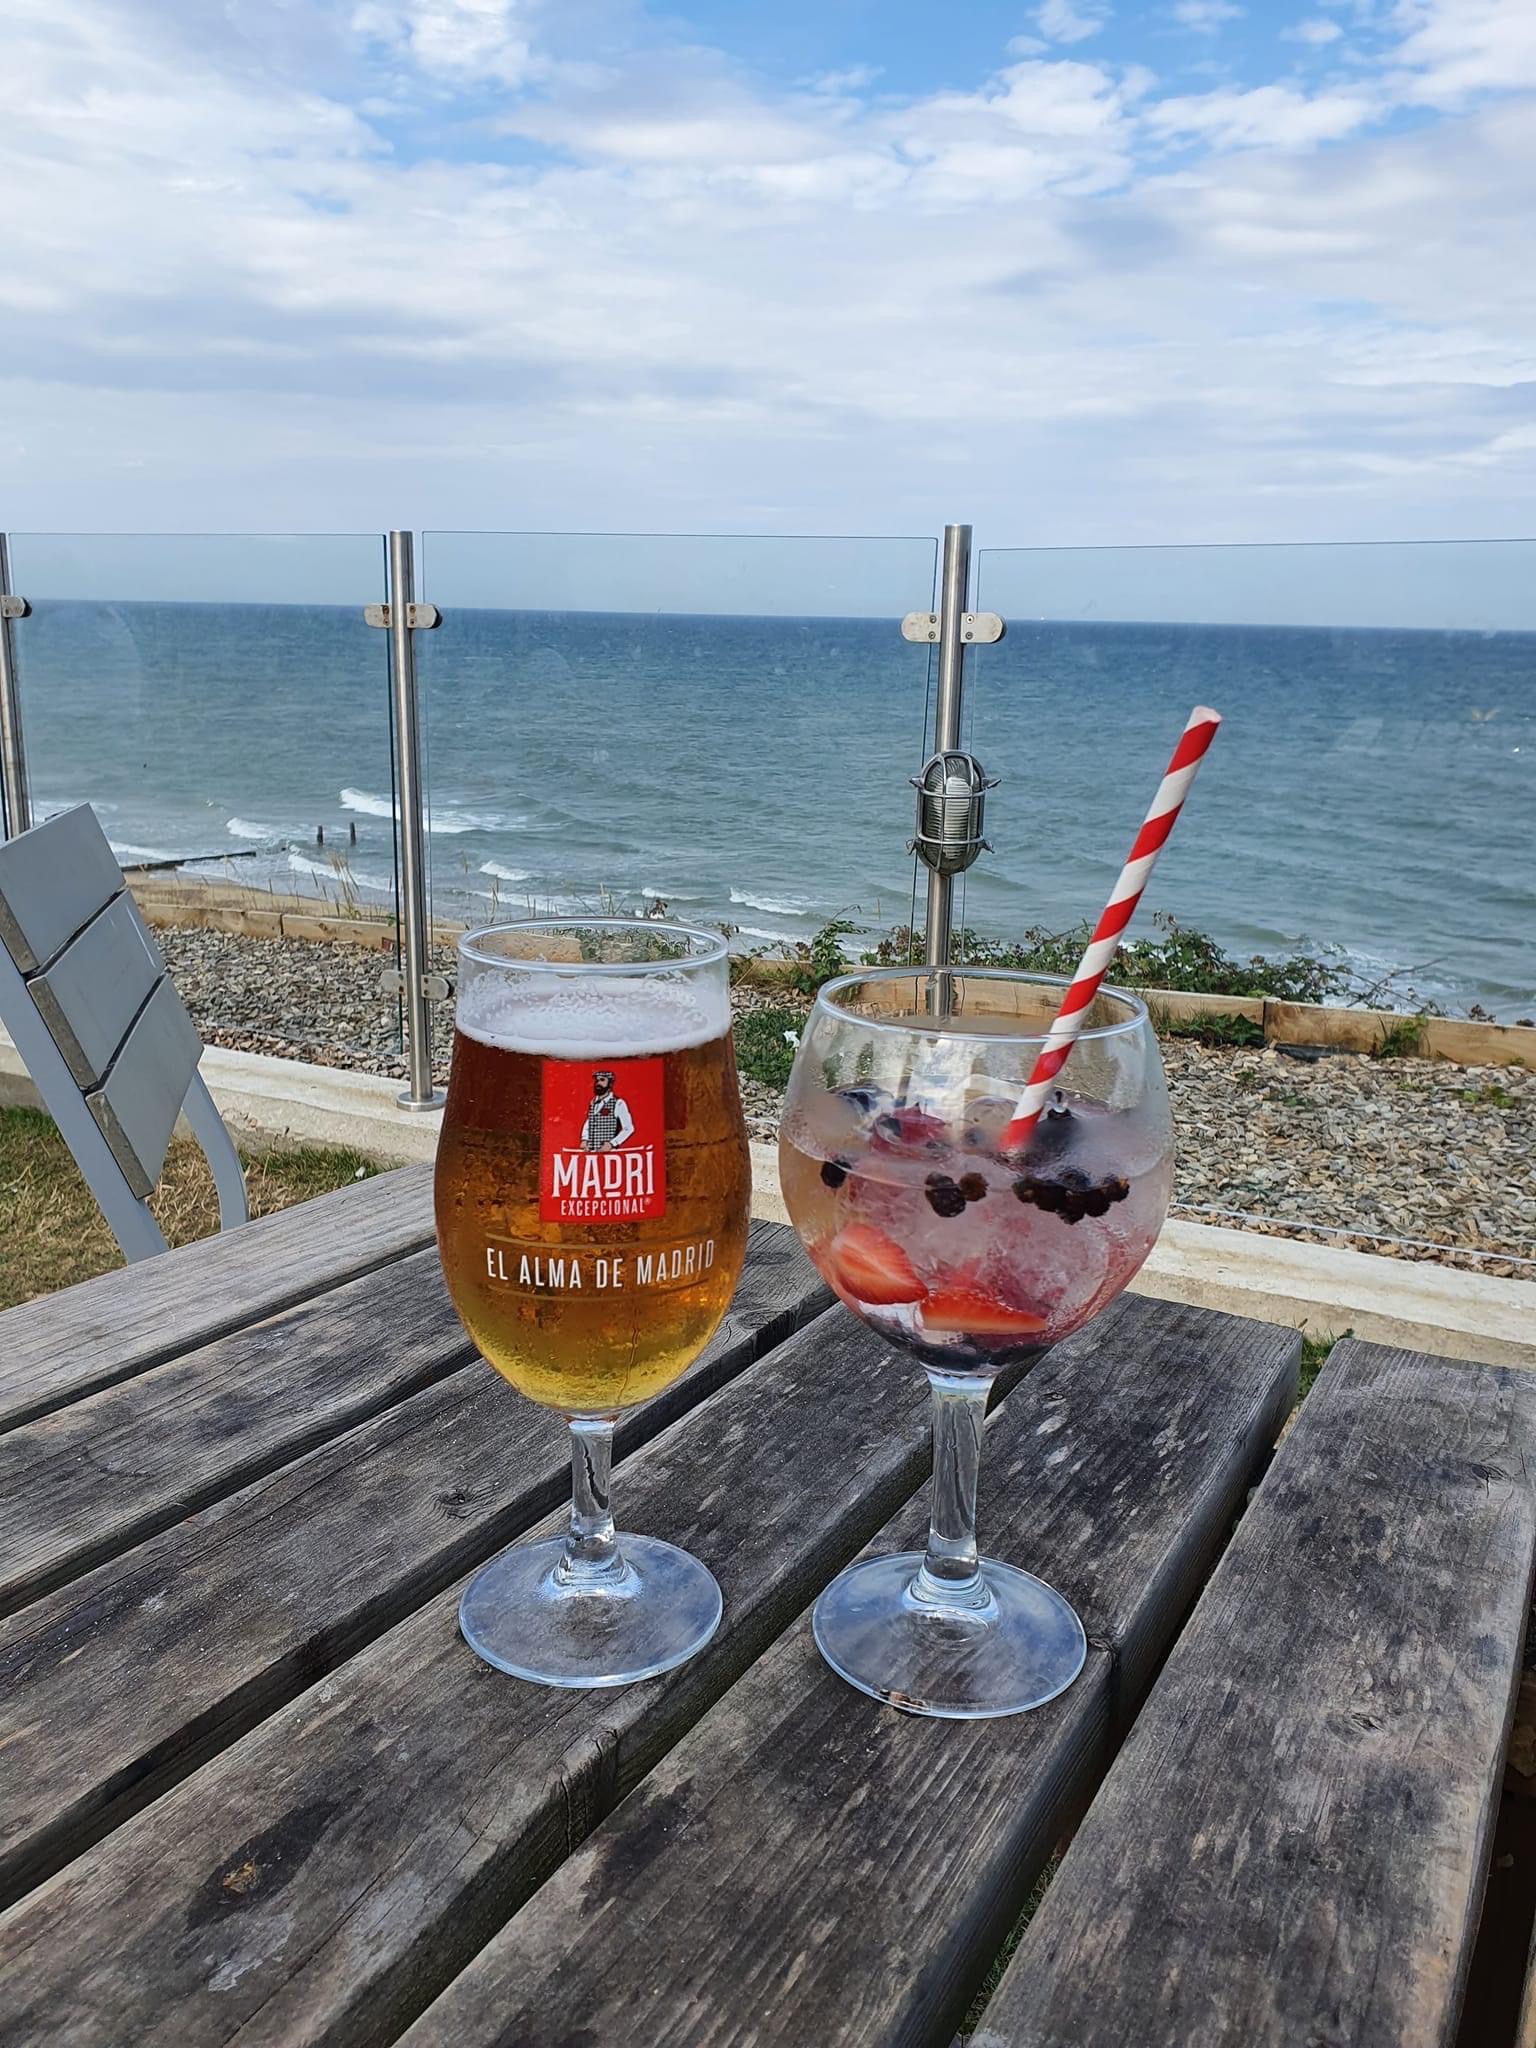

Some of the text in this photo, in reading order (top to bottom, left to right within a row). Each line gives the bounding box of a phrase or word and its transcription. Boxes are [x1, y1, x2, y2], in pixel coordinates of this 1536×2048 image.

[552, 1145, 655, 1199] MADRÍ
[486, 1239, 715, 1289] EL ALMA DE MADRID
